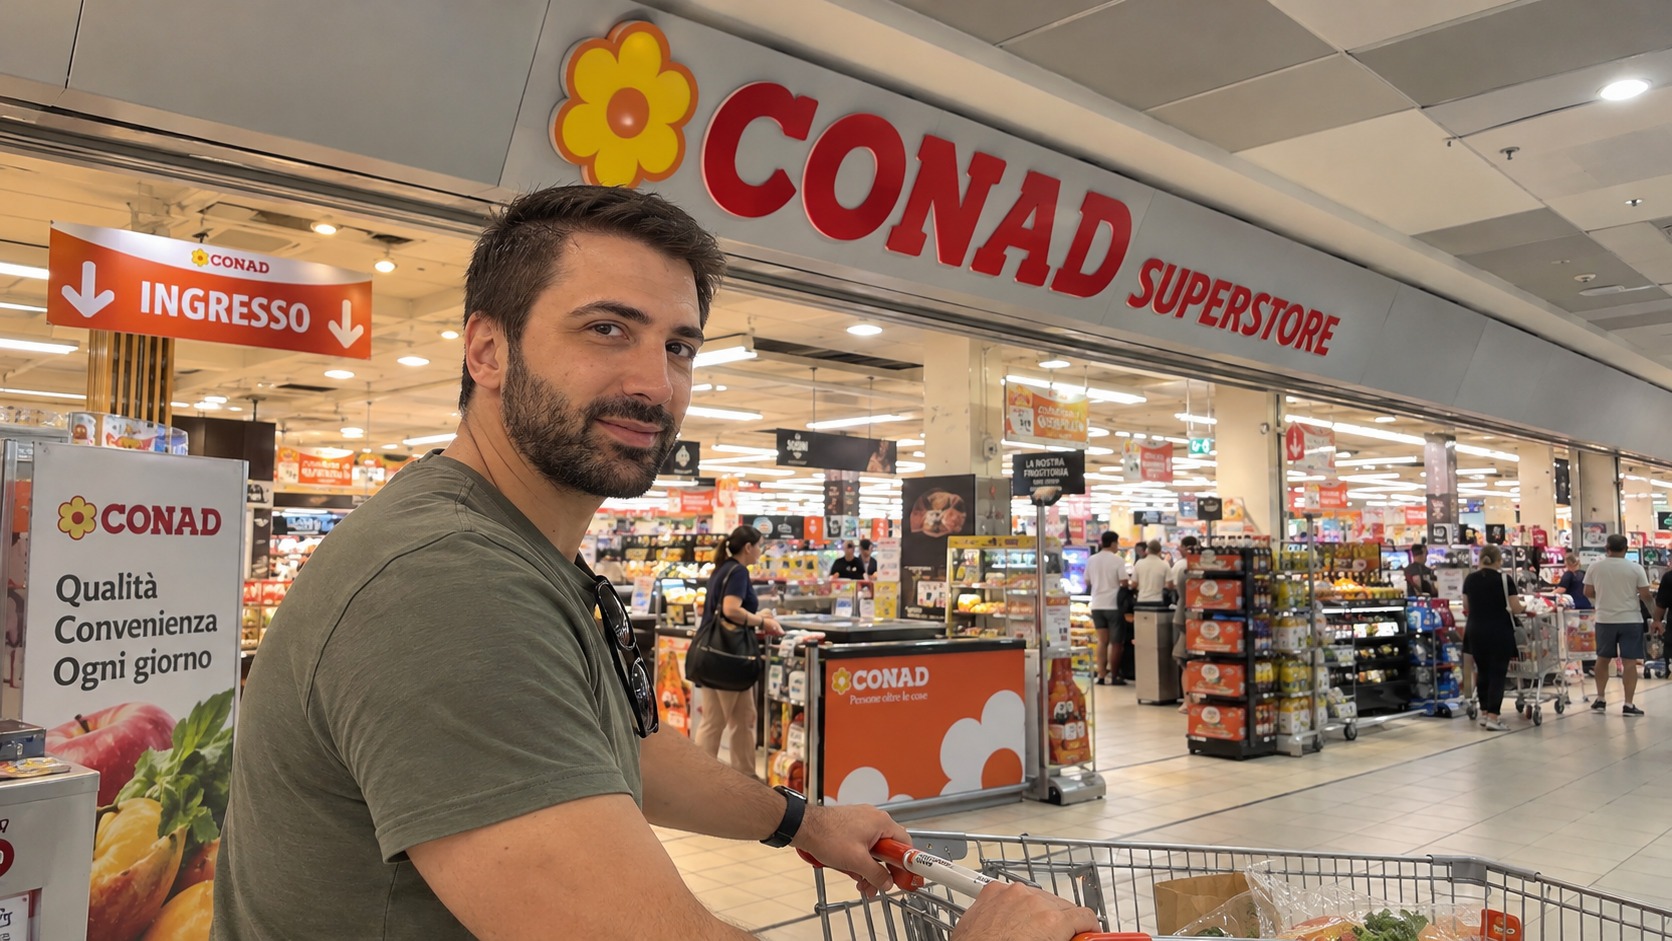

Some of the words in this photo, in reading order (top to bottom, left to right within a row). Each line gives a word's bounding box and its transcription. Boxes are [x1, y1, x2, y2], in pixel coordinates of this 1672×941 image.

[702, 82, 1132, 298] CONAD
[1126, 257, 1341, 357] SUPERSTORE
[210, 254, 270, 274] CONAD
[140, 280, 311, 334] INGRESSO
[101, 503, 222, 537] CONAD
[56, 571, 158, 607] Qualità
[55, 609, 218, 644] Convenienza
[53, 650, 126, 691] Ogni
[133, 647, 212, 685] giorno
[852, 666, 930, 691] CONAD
